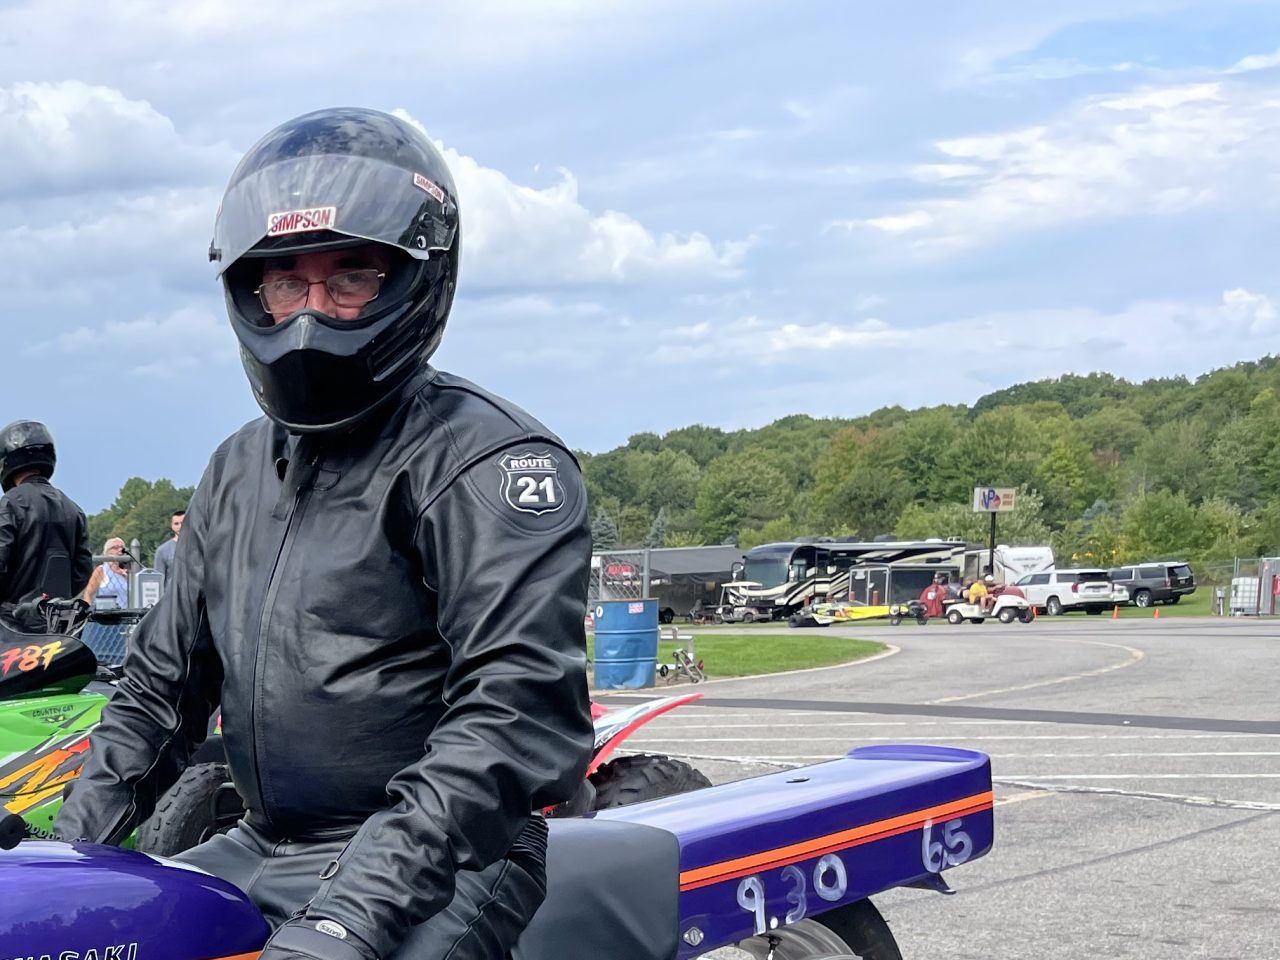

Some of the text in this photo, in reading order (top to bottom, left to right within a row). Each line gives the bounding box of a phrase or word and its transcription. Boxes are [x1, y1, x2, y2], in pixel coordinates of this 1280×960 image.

[416, 175, 443, 199] SIMPSON
[271, 209, 331, 233] SIMPSON
[510, 459, 552, 469] ROUTE
[517, 476, 556, 503] 21
[0, 640, 66, 677] 787
